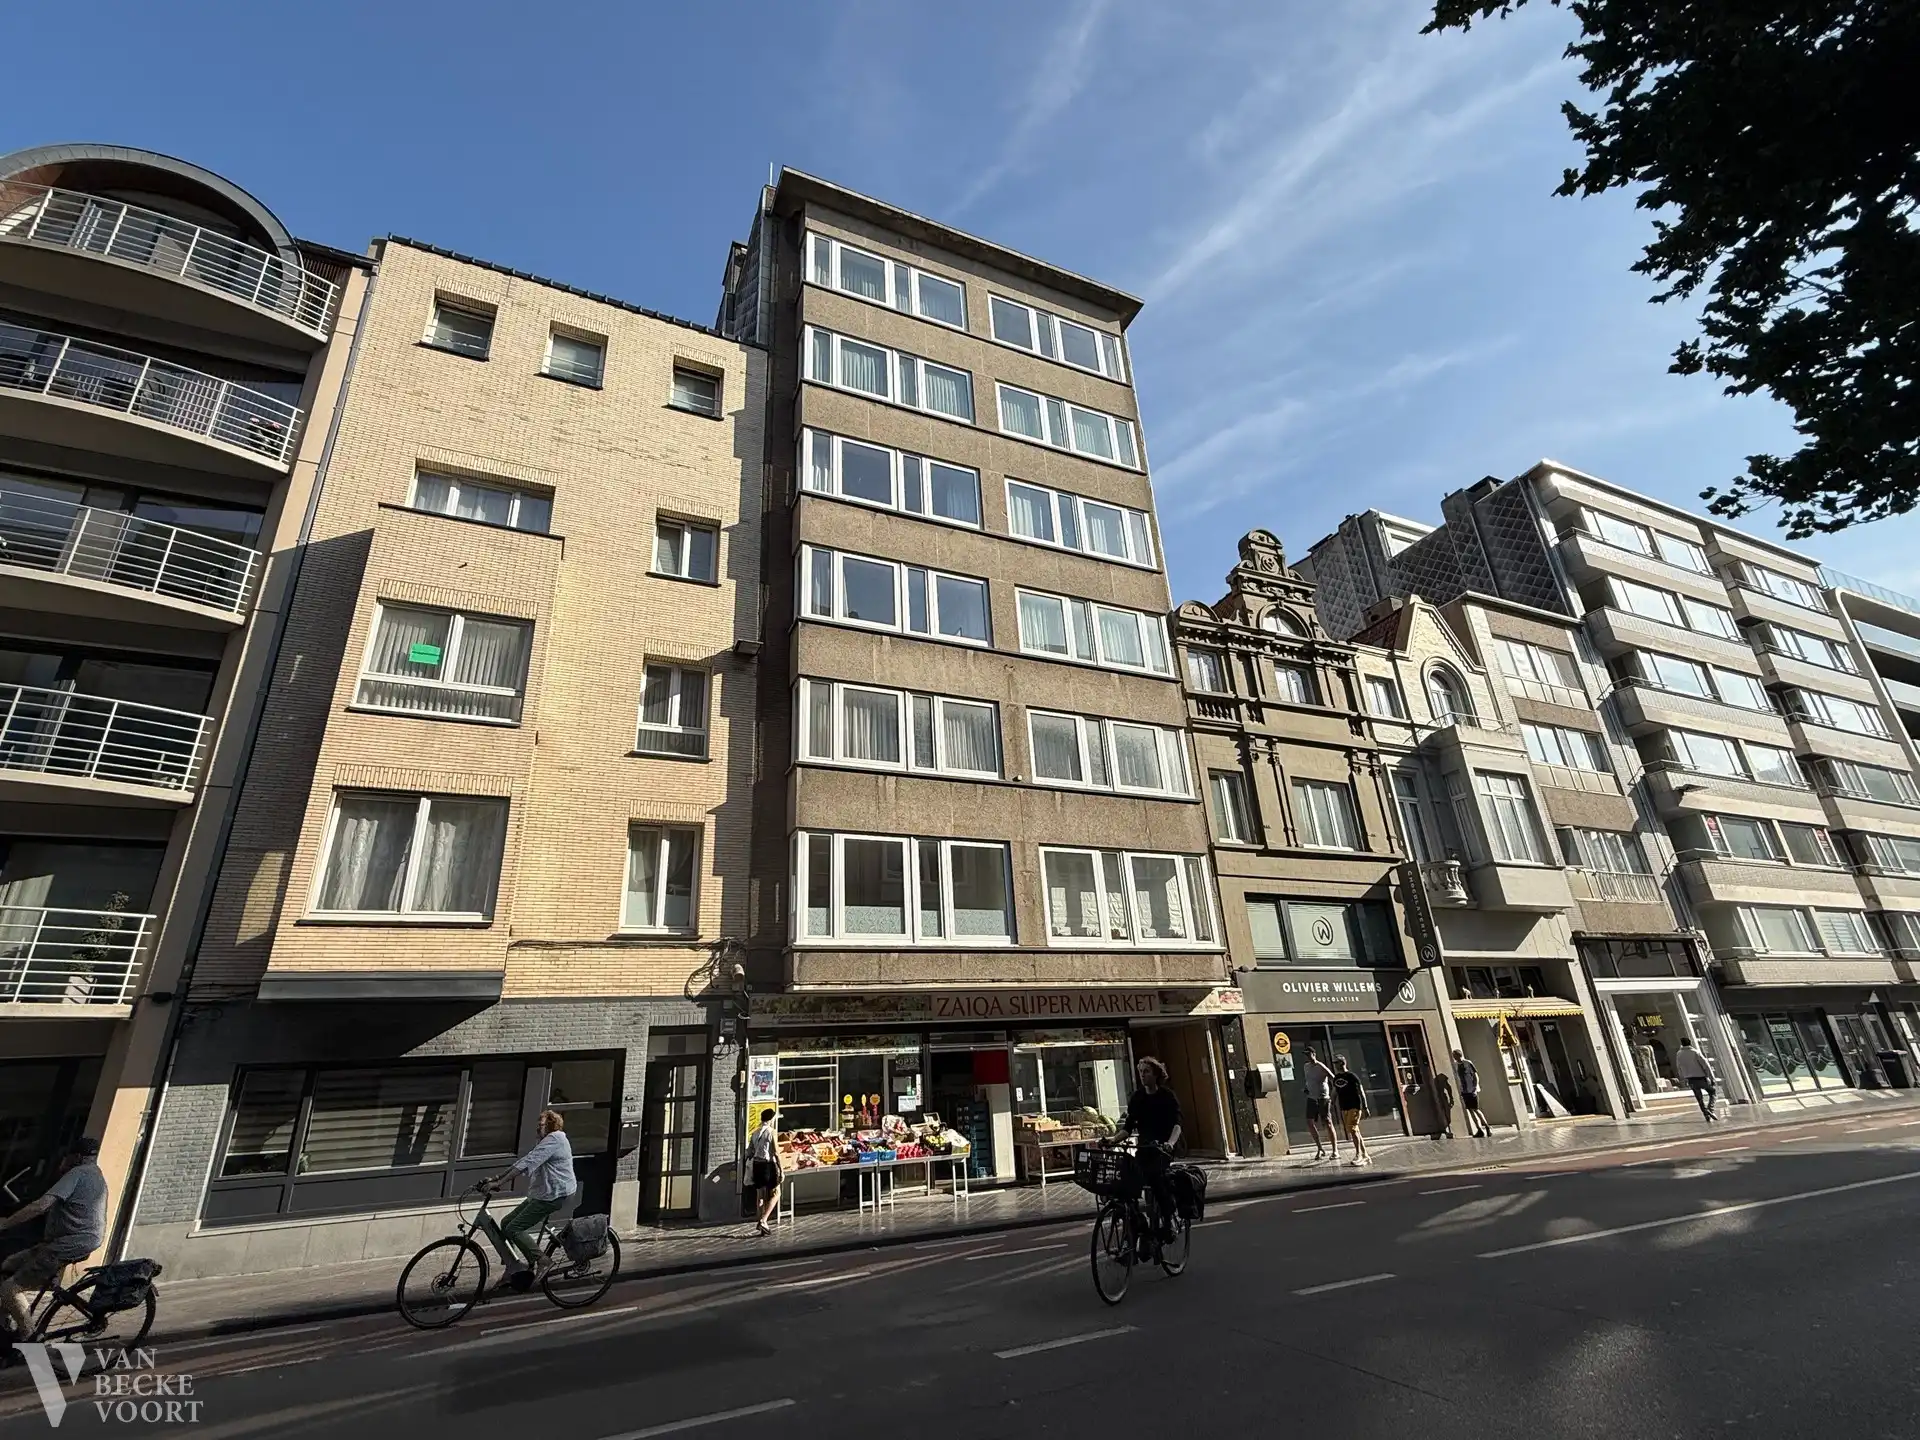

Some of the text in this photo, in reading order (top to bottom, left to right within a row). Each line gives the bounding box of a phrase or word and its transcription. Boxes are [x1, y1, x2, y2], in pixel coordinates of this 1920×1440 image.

[1283, 983, 1382, 992] OLIVIER WILLEMS
[937, 994, 1156, 1018] ZAIQA SUPER MARKET
